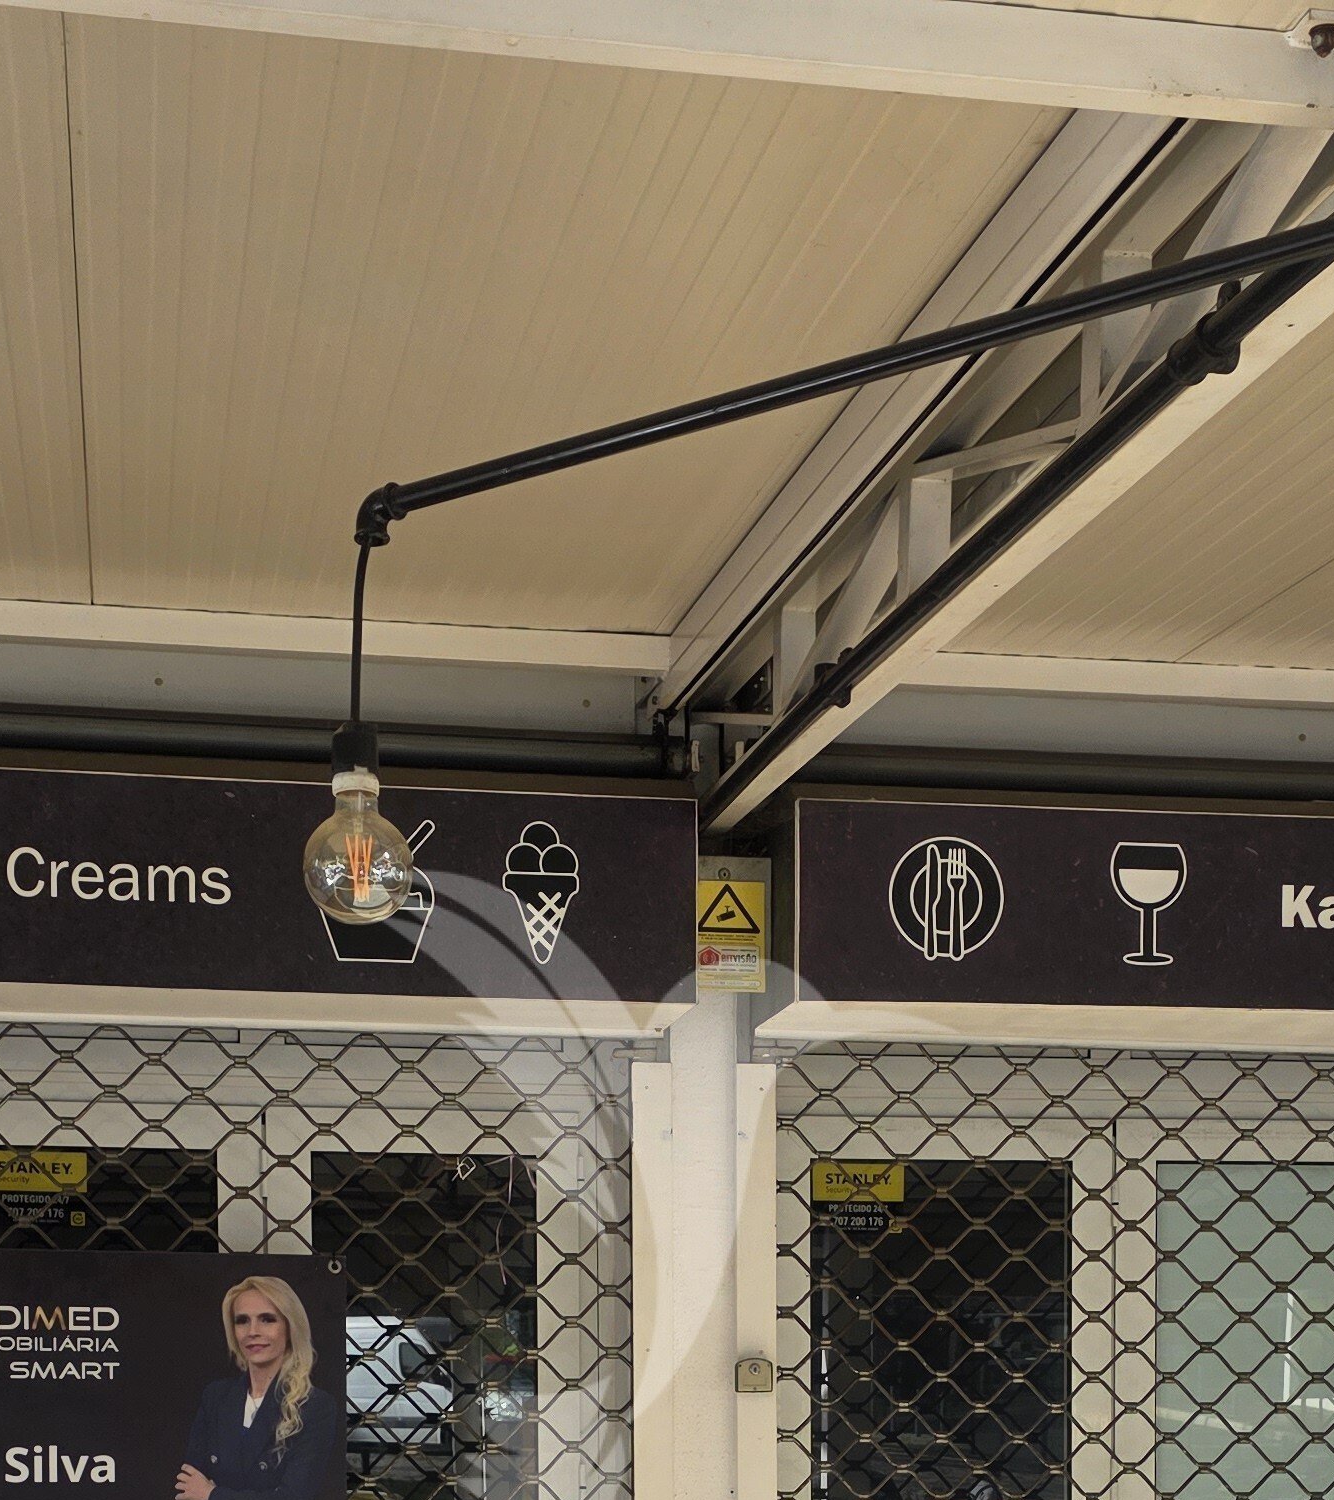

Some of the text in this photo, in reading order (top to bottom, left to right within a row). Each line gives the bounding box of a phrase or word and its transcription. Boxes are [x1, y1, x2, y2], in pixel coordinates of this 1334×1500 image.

[5, 846, 232, 906] Creams
[47, 1208, 65, 1218] 176
[833, 1216, 884, 1227] 707 200 176
[9, 1361, 121, 1380] SMART
[4, 1445, 117, 1484] Silva
